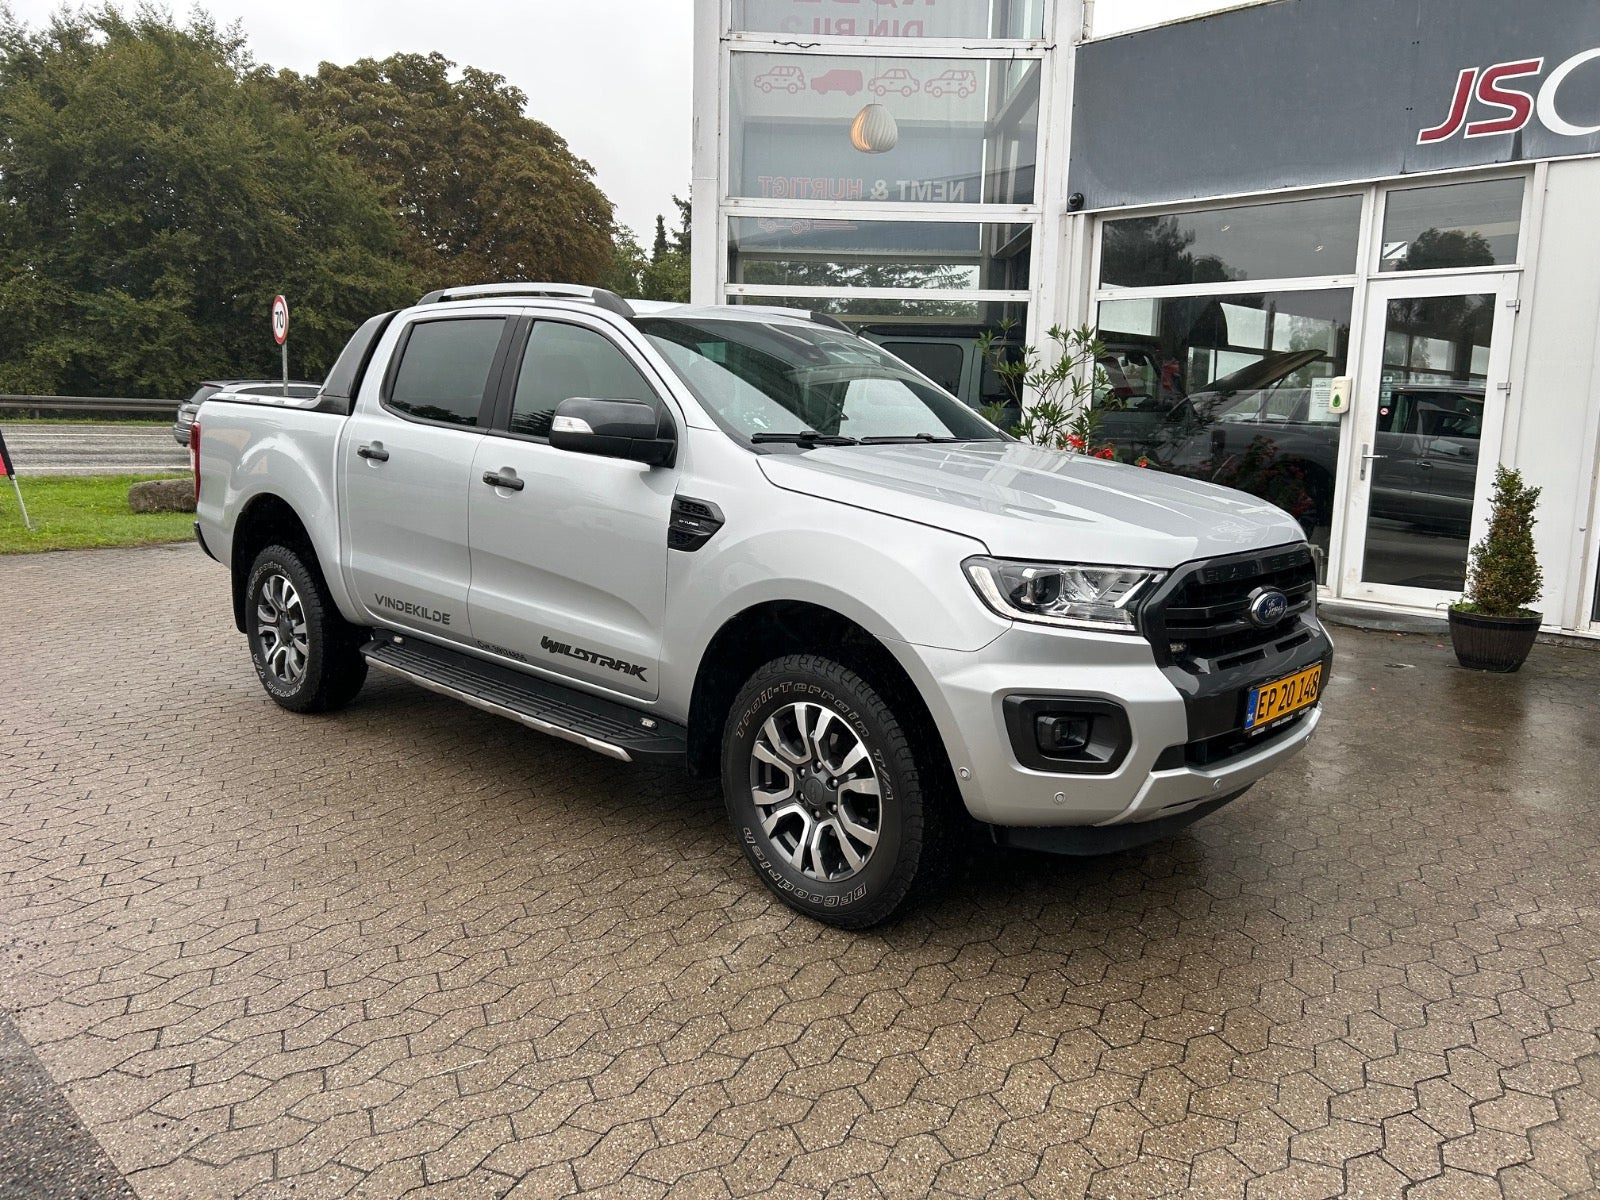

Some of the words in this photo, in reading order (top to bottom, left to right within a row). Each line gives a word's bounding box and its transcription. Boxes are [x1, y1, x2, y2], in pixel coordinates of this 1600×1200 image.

[275, 310, 284, 329] 70
[375, 593, 451, 625] VINDEKILDE
[736, 681, 870, 739] Trail-Terrain
[1256, 688, 1277, 720] EP
[1278, 680, 1295, 711] 20
[1297, 670, 1319, 704] 148
[873, 748, 894, 800] T/A
[743, 826, 867, 908] BFGoodrich
